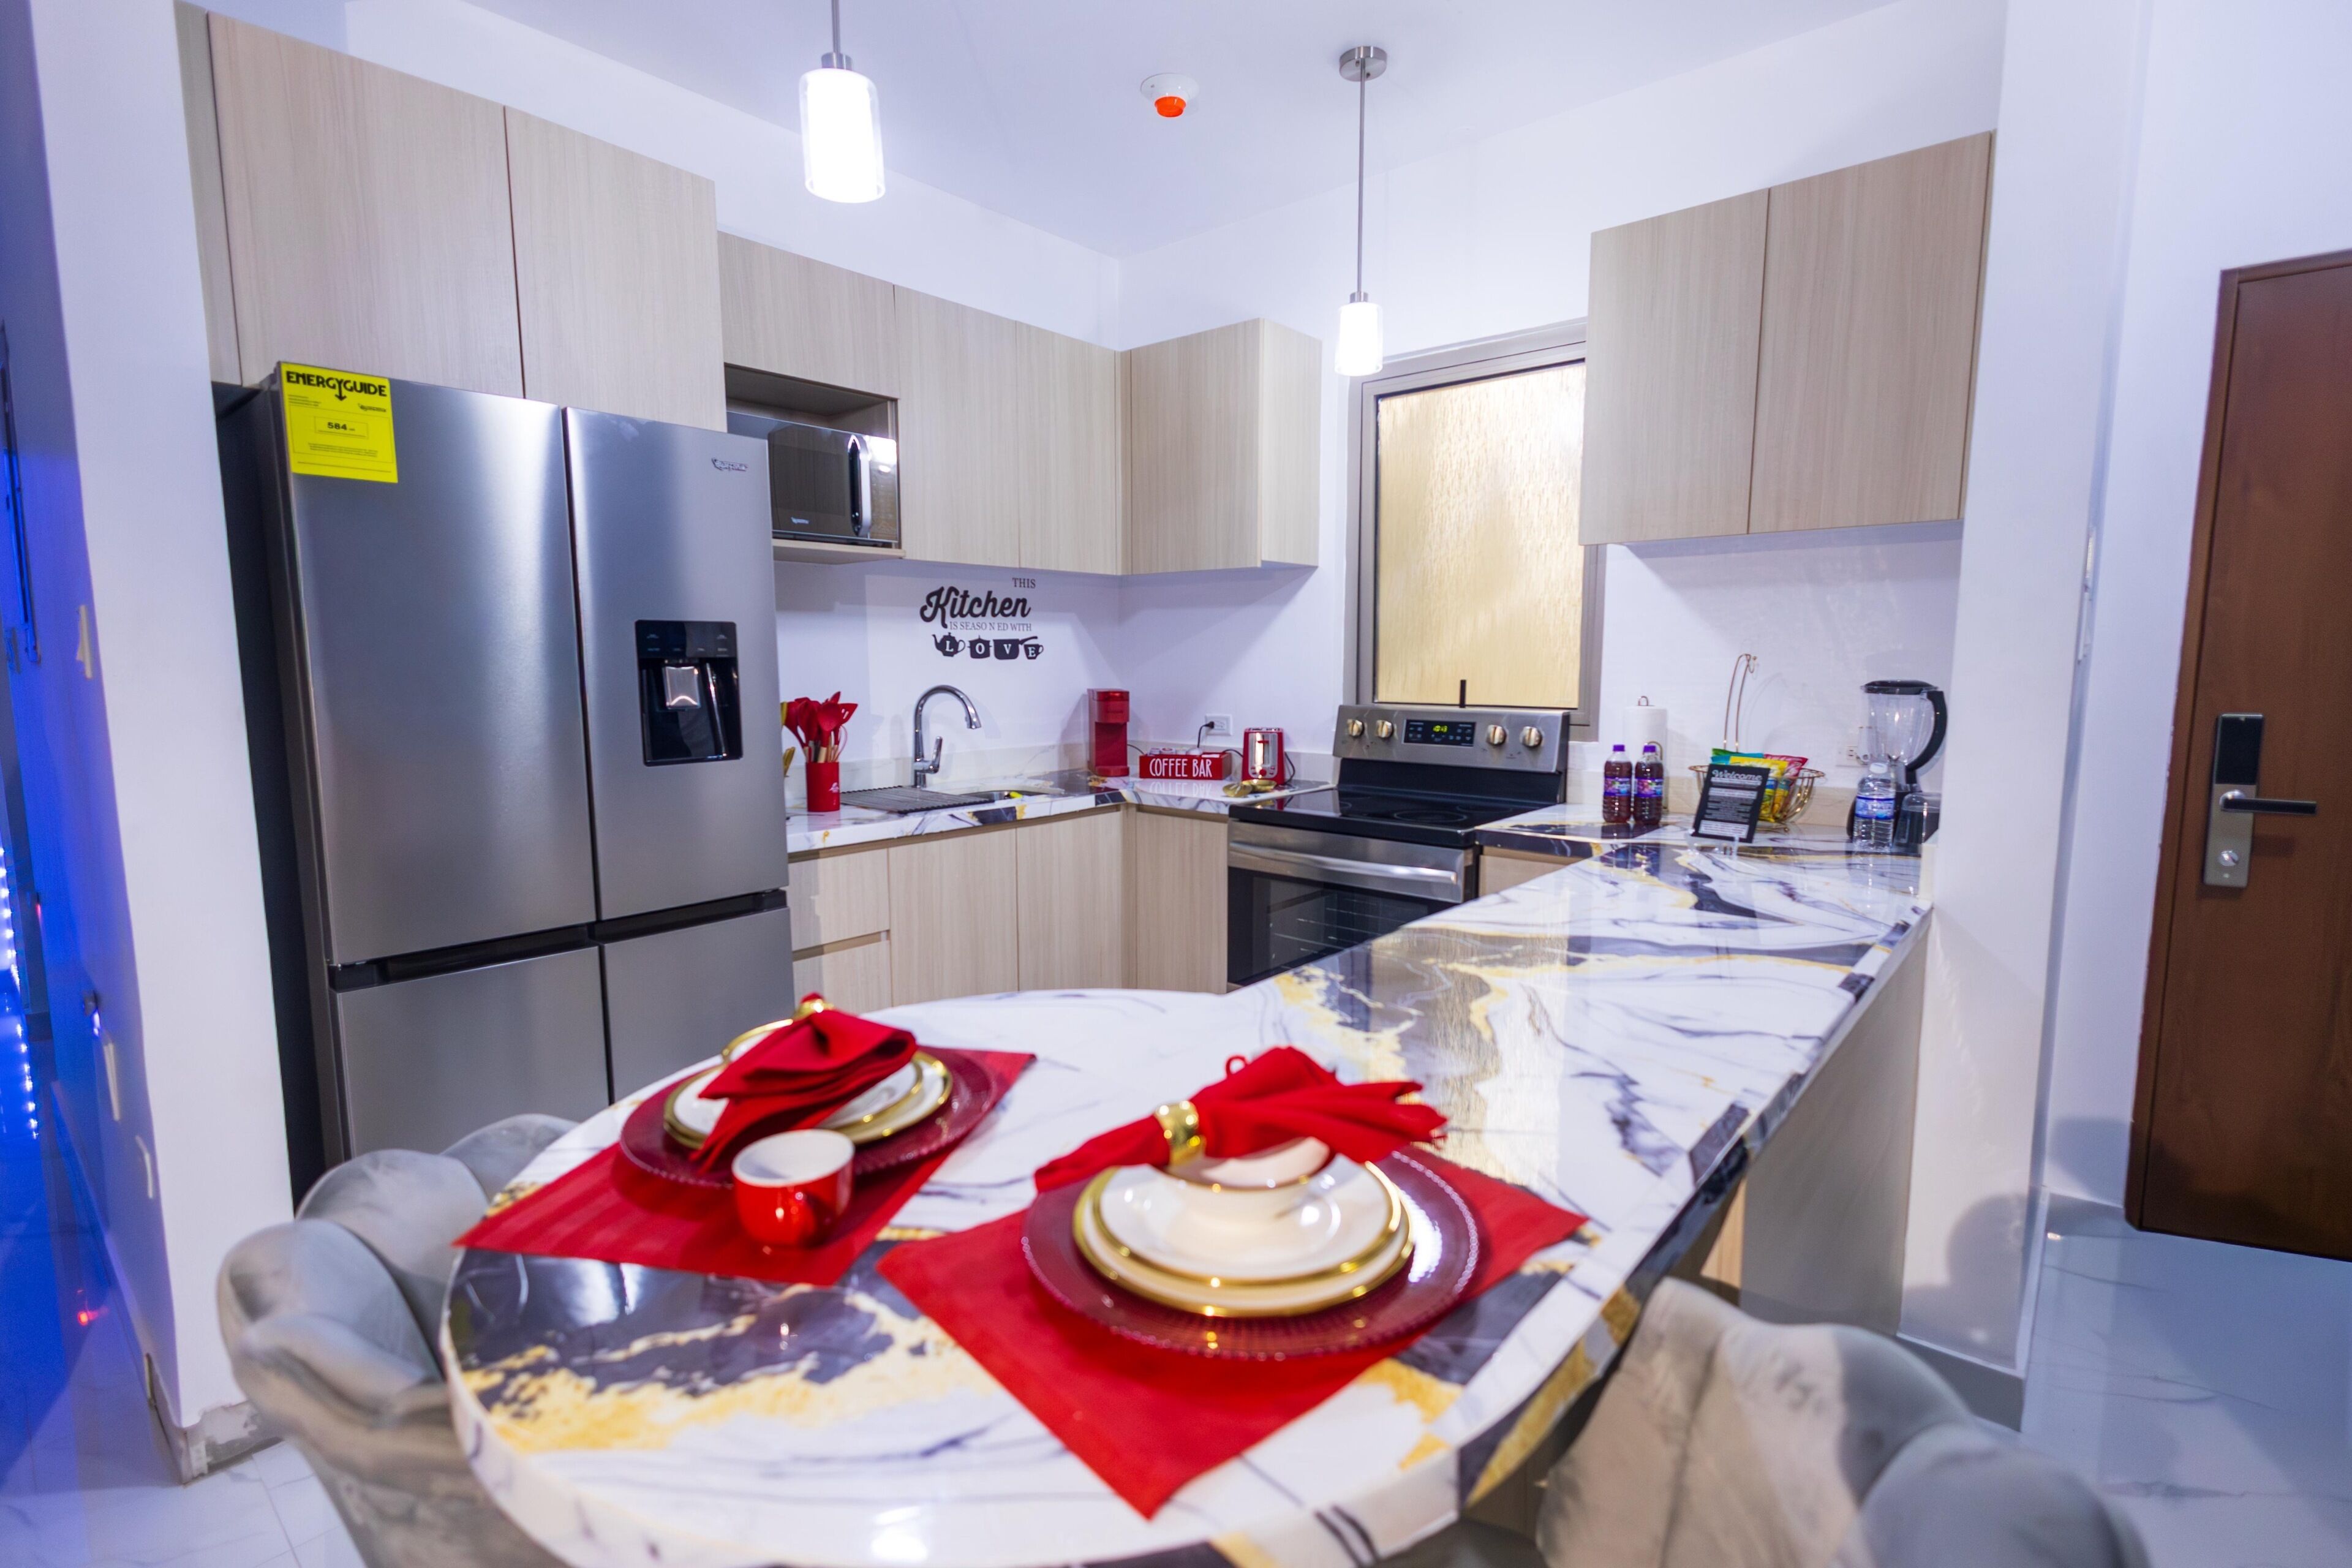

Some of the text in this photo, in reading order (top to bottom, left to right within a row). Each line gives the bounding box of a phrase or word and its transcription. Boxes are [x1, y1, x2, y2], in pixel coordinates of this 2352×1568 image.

[286, 371, 387, 397] ENERGYGUIDE
[327, 421, 347, 431] 584
[1012, 578, 1036, 589] THIS
[919, 586, 1031, 629] Kitchen
[949, 621, 958, 630] IS
[1010, 623, 1032, 631] WITH
[1149, 758, 1213, 777] COFFEE BAR
[1711, 769, 1763, 781] Welcome
